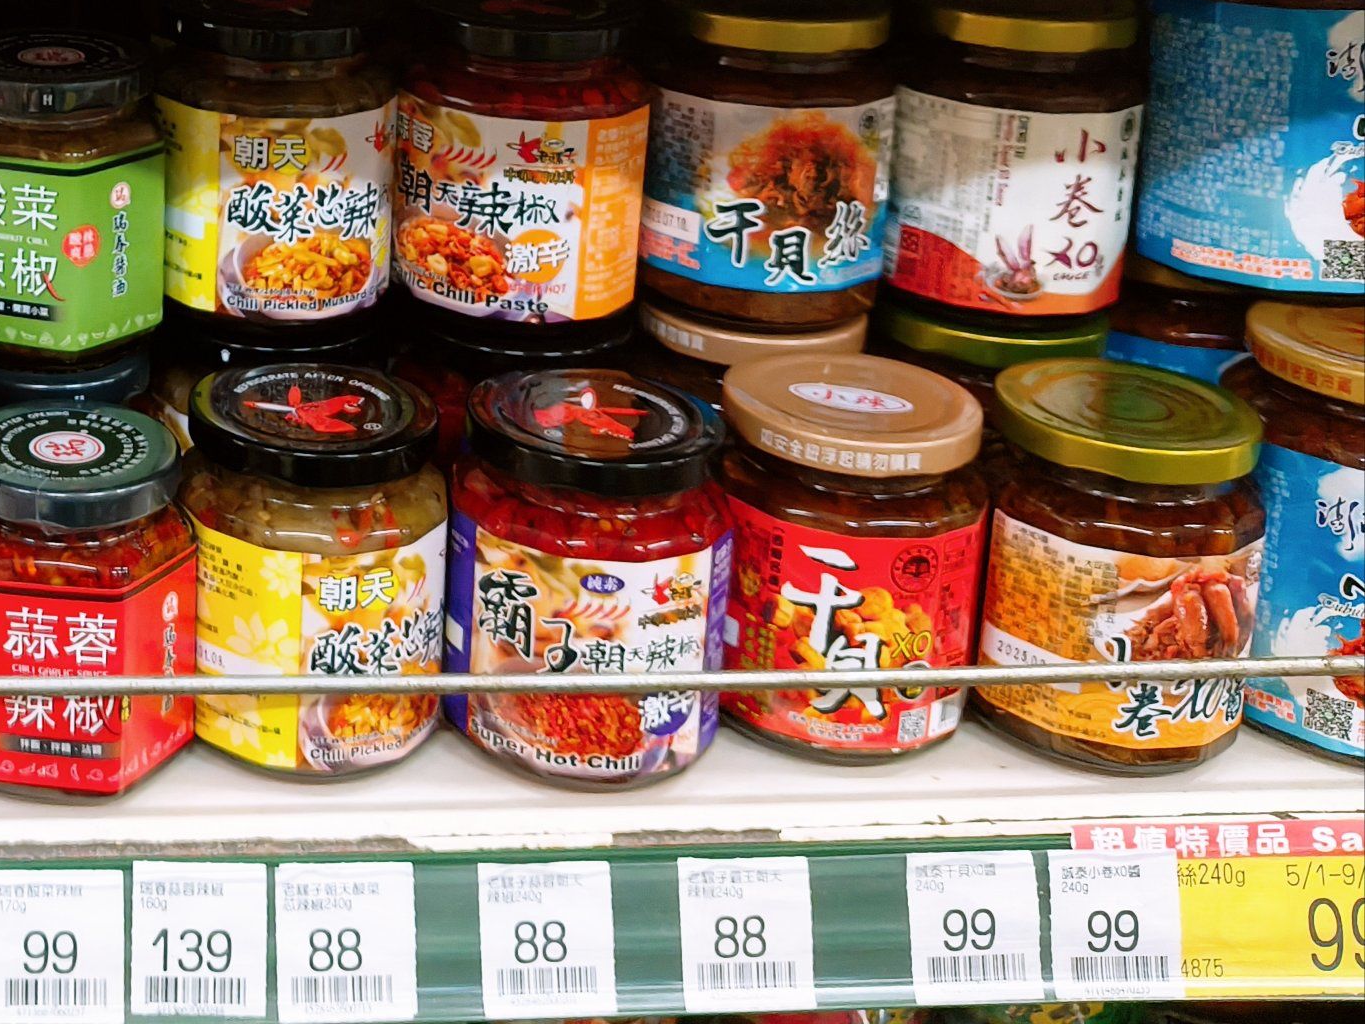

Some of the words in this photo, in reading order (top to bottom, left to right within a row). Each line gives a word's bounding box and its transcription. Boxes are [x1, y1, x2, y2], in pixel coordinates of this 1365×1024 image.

[234, 135, 306, 171] 朝天
[264, 299, 317, 310] Pickled
[485, 294, 549, 314] Paste
[319, 570, 394, 612] 朝天
[3, 606, 117, 667] 蒜蓉
[535, 748, 579, 767] Hot
[587, 755, 640, 771] Chili
[1089, 824, 1290, 857] 超值特價品
[1061, 881, 1089, 894] 240g
[151, 928, 233, 973] 139
[308, 928, 363, 972] 88
[513, 920, 568, 964] 88
[714, 915, 768, 959] 88
[943, 908, 997, 952] 99
[1087, 910, 1140, 953] 99
[22, 930, 79, 975] 99
